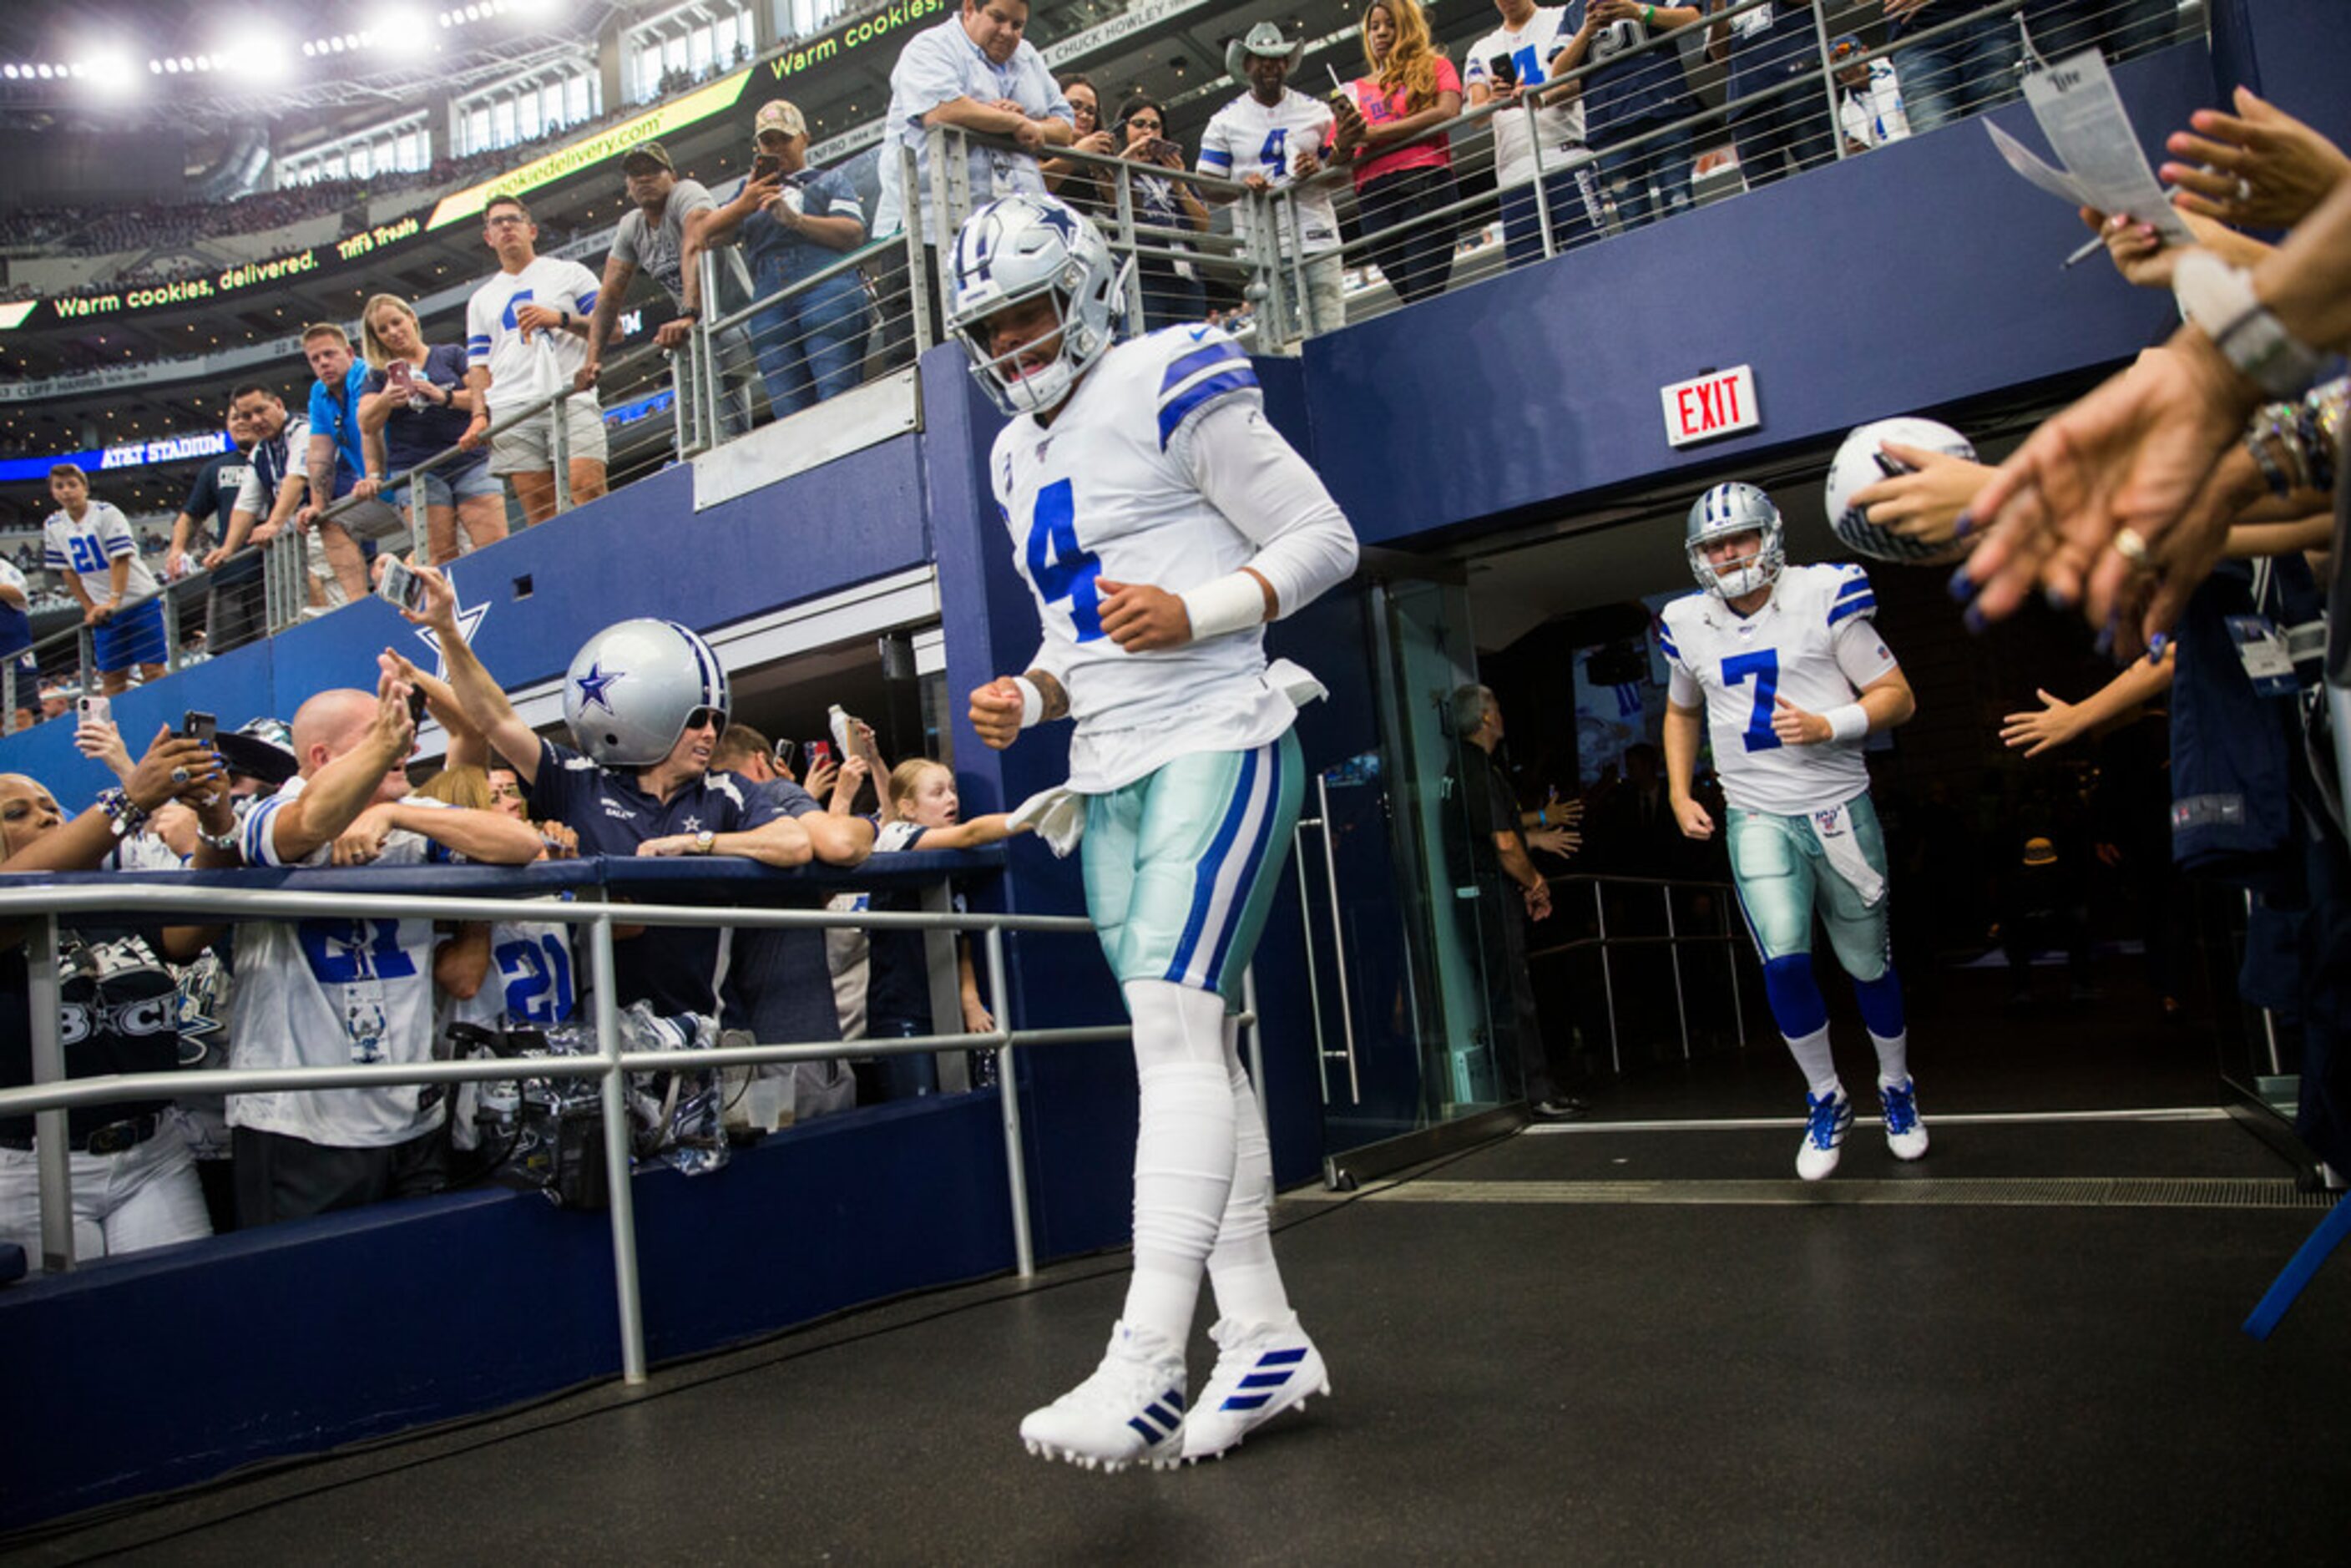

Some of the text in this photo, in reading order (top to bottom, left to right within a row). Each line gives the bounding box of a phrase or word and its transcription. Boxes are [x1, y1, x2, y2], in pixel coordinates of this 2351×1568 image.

[770, 0, 946, 79] Warm cookies,
[1054, 29, 1102, 60] CHUCK
[1105, 3, 1164, 38] HOWLEY
[486, 117, 660, 200] cookiedelivery.com
[1260, 128, 1288, 178] 4
[54, 294, 121, 318] Warm
[126, 280, 215, 309] cookies,
[219, 250, 320, 291] delivered.
[1677, 375, 1740, 436] EXIT
[100, 431, 226, 469] AT&T STADIUM
[68, 534, 110, 574] 21
[1026, 476, 1111, 644] 4
[1721, 647, 1783, 753] 7
[494, 933, 573, 1024] 21
